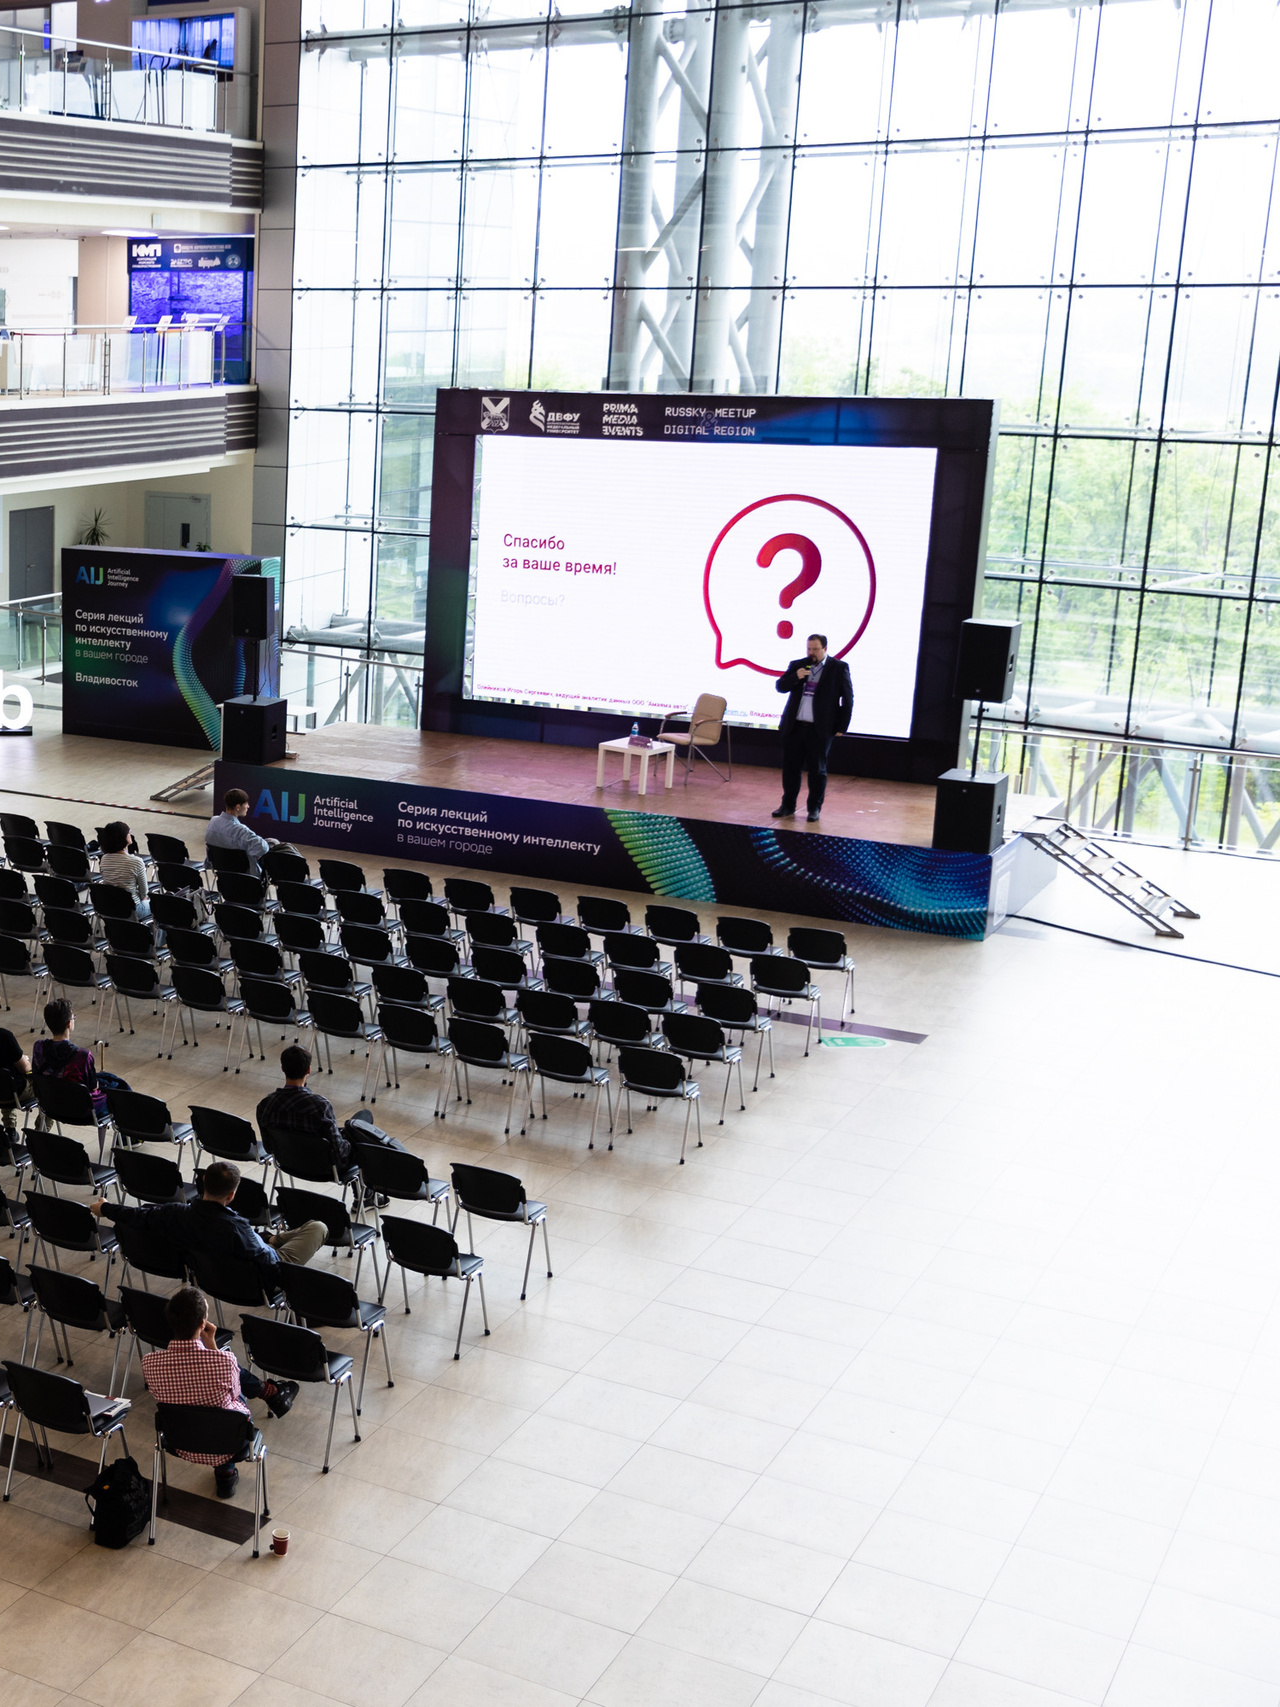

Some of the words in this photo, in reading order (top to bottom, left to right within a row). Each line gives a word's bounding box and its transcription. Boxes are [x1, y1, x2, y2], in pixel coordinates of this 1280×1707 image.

[603, 403, 638, 413] PRIMA
[665, 407, 706, 417] RUSSKY
[715, 408, 756, 418] MEETUP
[547, 412, 580, 422] ДВФУ
[603, 415, 637, 424] MEDIA
[603, 426, 643, 436] EVENTS
[664, 425, 709, 435] DIGITAL
[714, 426, 755, 436] REGION
[504, 534, 565, 550] Спасибо
[503, 558, 518, 568] за
[523, 559, 560, 571] ваше
[565, 562, 616, 575] время!
[75, 566, 103, 585] AIJ
[107, 574, 139, 582] Intelligence
[501, 590, 565, 607] Вопросы?
[75, 609, 105, 621] Серия
[107, 614, 143, 624] лекций
[75, 624, 87, 632] по
[90, 625, 168, 641] искусственному
[75, 637, 131, 650] интеллекту
[83, 650, 112, 660] вашем
[115, 652, 148, 663] городе
[75, 672, 138, 687] Владивосток
[252, 789, 306, 823] AIJ
[314, 796, 358, 810] Artificial
[314, 806, 373, 823] Intelligence
[398, 802, 436, 817] Серия
[440, 809, 488, 823] лекций
[313, 817, 353, 832] Journey
[397, 834, 404, 842] в
[408, 834, 446, 847] вашем
[450, 841, 493, 854] городе
[398, 818, 413, 828] по
[416, 820, 520, 844] искусственному
[523, 835, 600, 855] интеллекту
